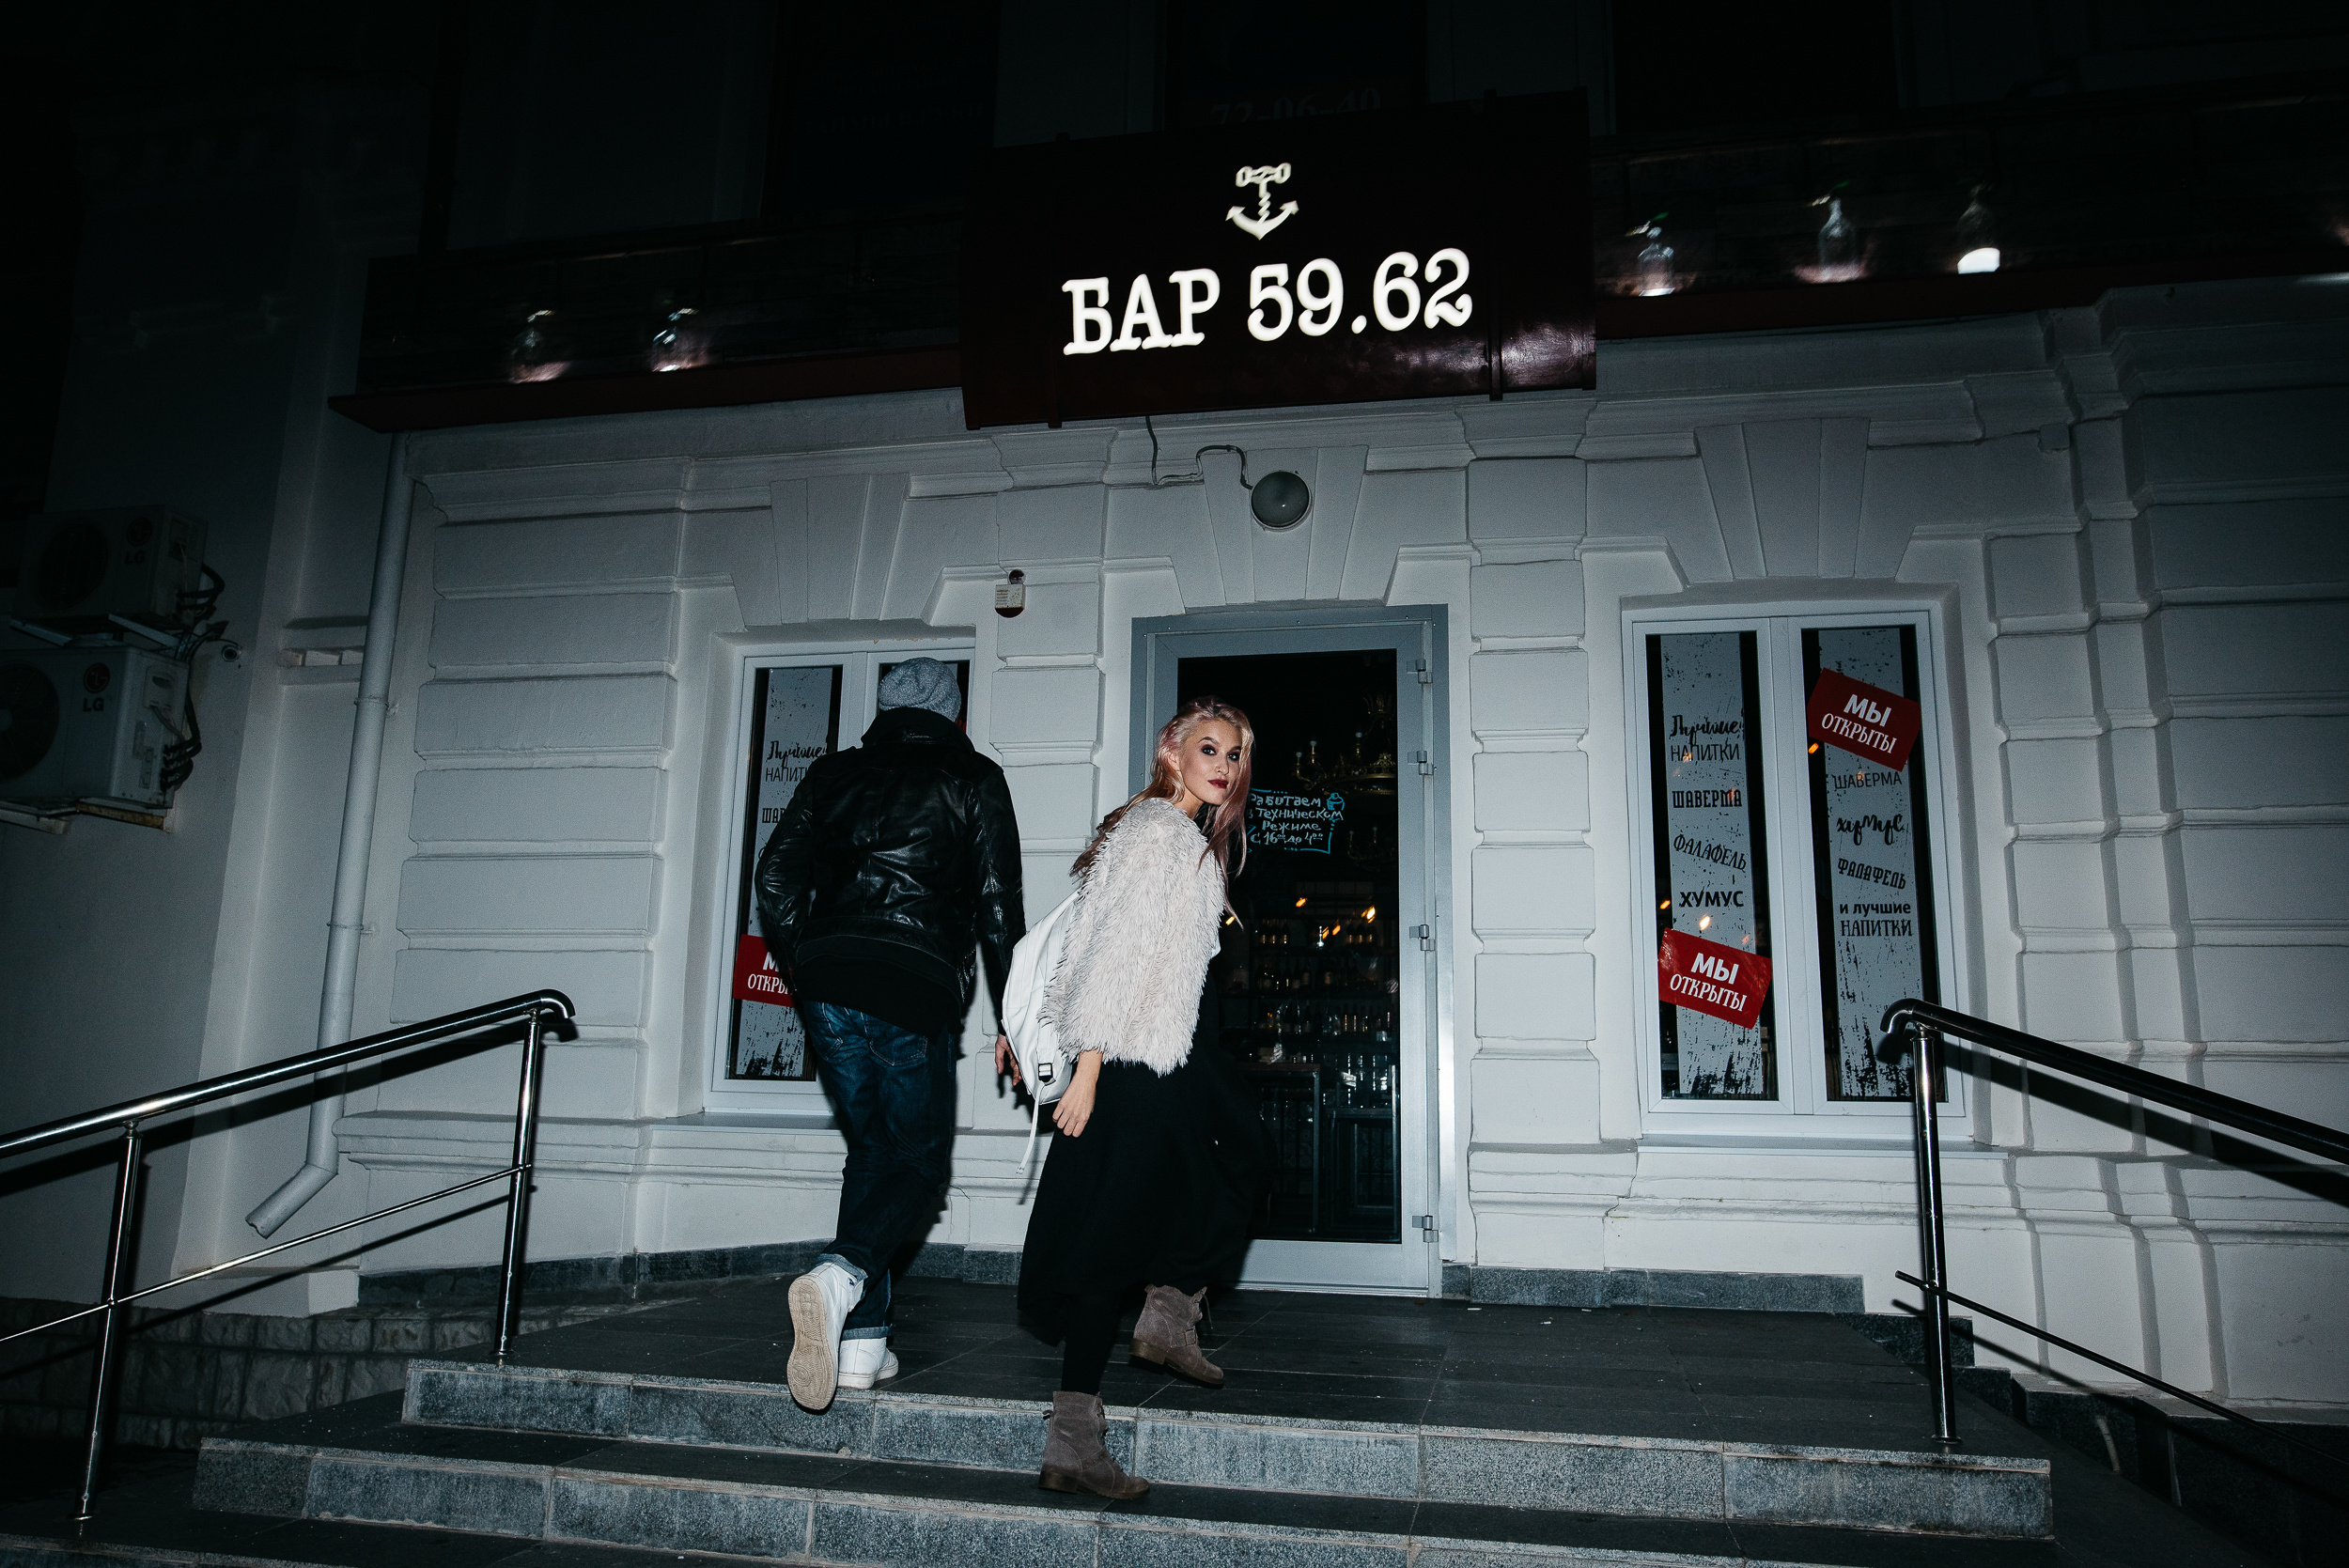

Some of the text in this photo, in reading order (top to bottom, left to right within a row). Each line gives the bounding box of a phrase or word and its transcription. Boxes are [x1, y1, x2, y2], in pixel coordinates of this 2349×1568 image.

[1062, 247, 1473, 355] БАР 59.62
[124, 551, 146, 564] LG
[83, 697, 104, 711] LG
[1843, 693, 1892, 727] МЫ
[1821, 712, 1898, 753] ОТКРЫТЫ
[1671, 743, 1739, 762] НАПИТКИ
[766, 767, 807, 782] НАПИТ
[1833, 771, 1903, 789] ШАВЕРМА
[1672, 789, 1742, 808] ШАВЕРМА
[1673, 833, 1747, 872] ФАЛАФЕЛЬ
[1838, 858, 1906, 890] ФАЛАФЕЛЬ
[1679, 891, 1744, 908] ХУМУС
[1839, 903, 1911, 917] и лучшие
[1841, 919, 1913, 937] НАПИТКИ
[763, 951, 780, 972] М
[1690, 952, 1739, 985] МЫ
[747, 973, 788, 995] ОТКРЫ
[1670, 973, 1748, 1012] ОТКРЫТЫ
